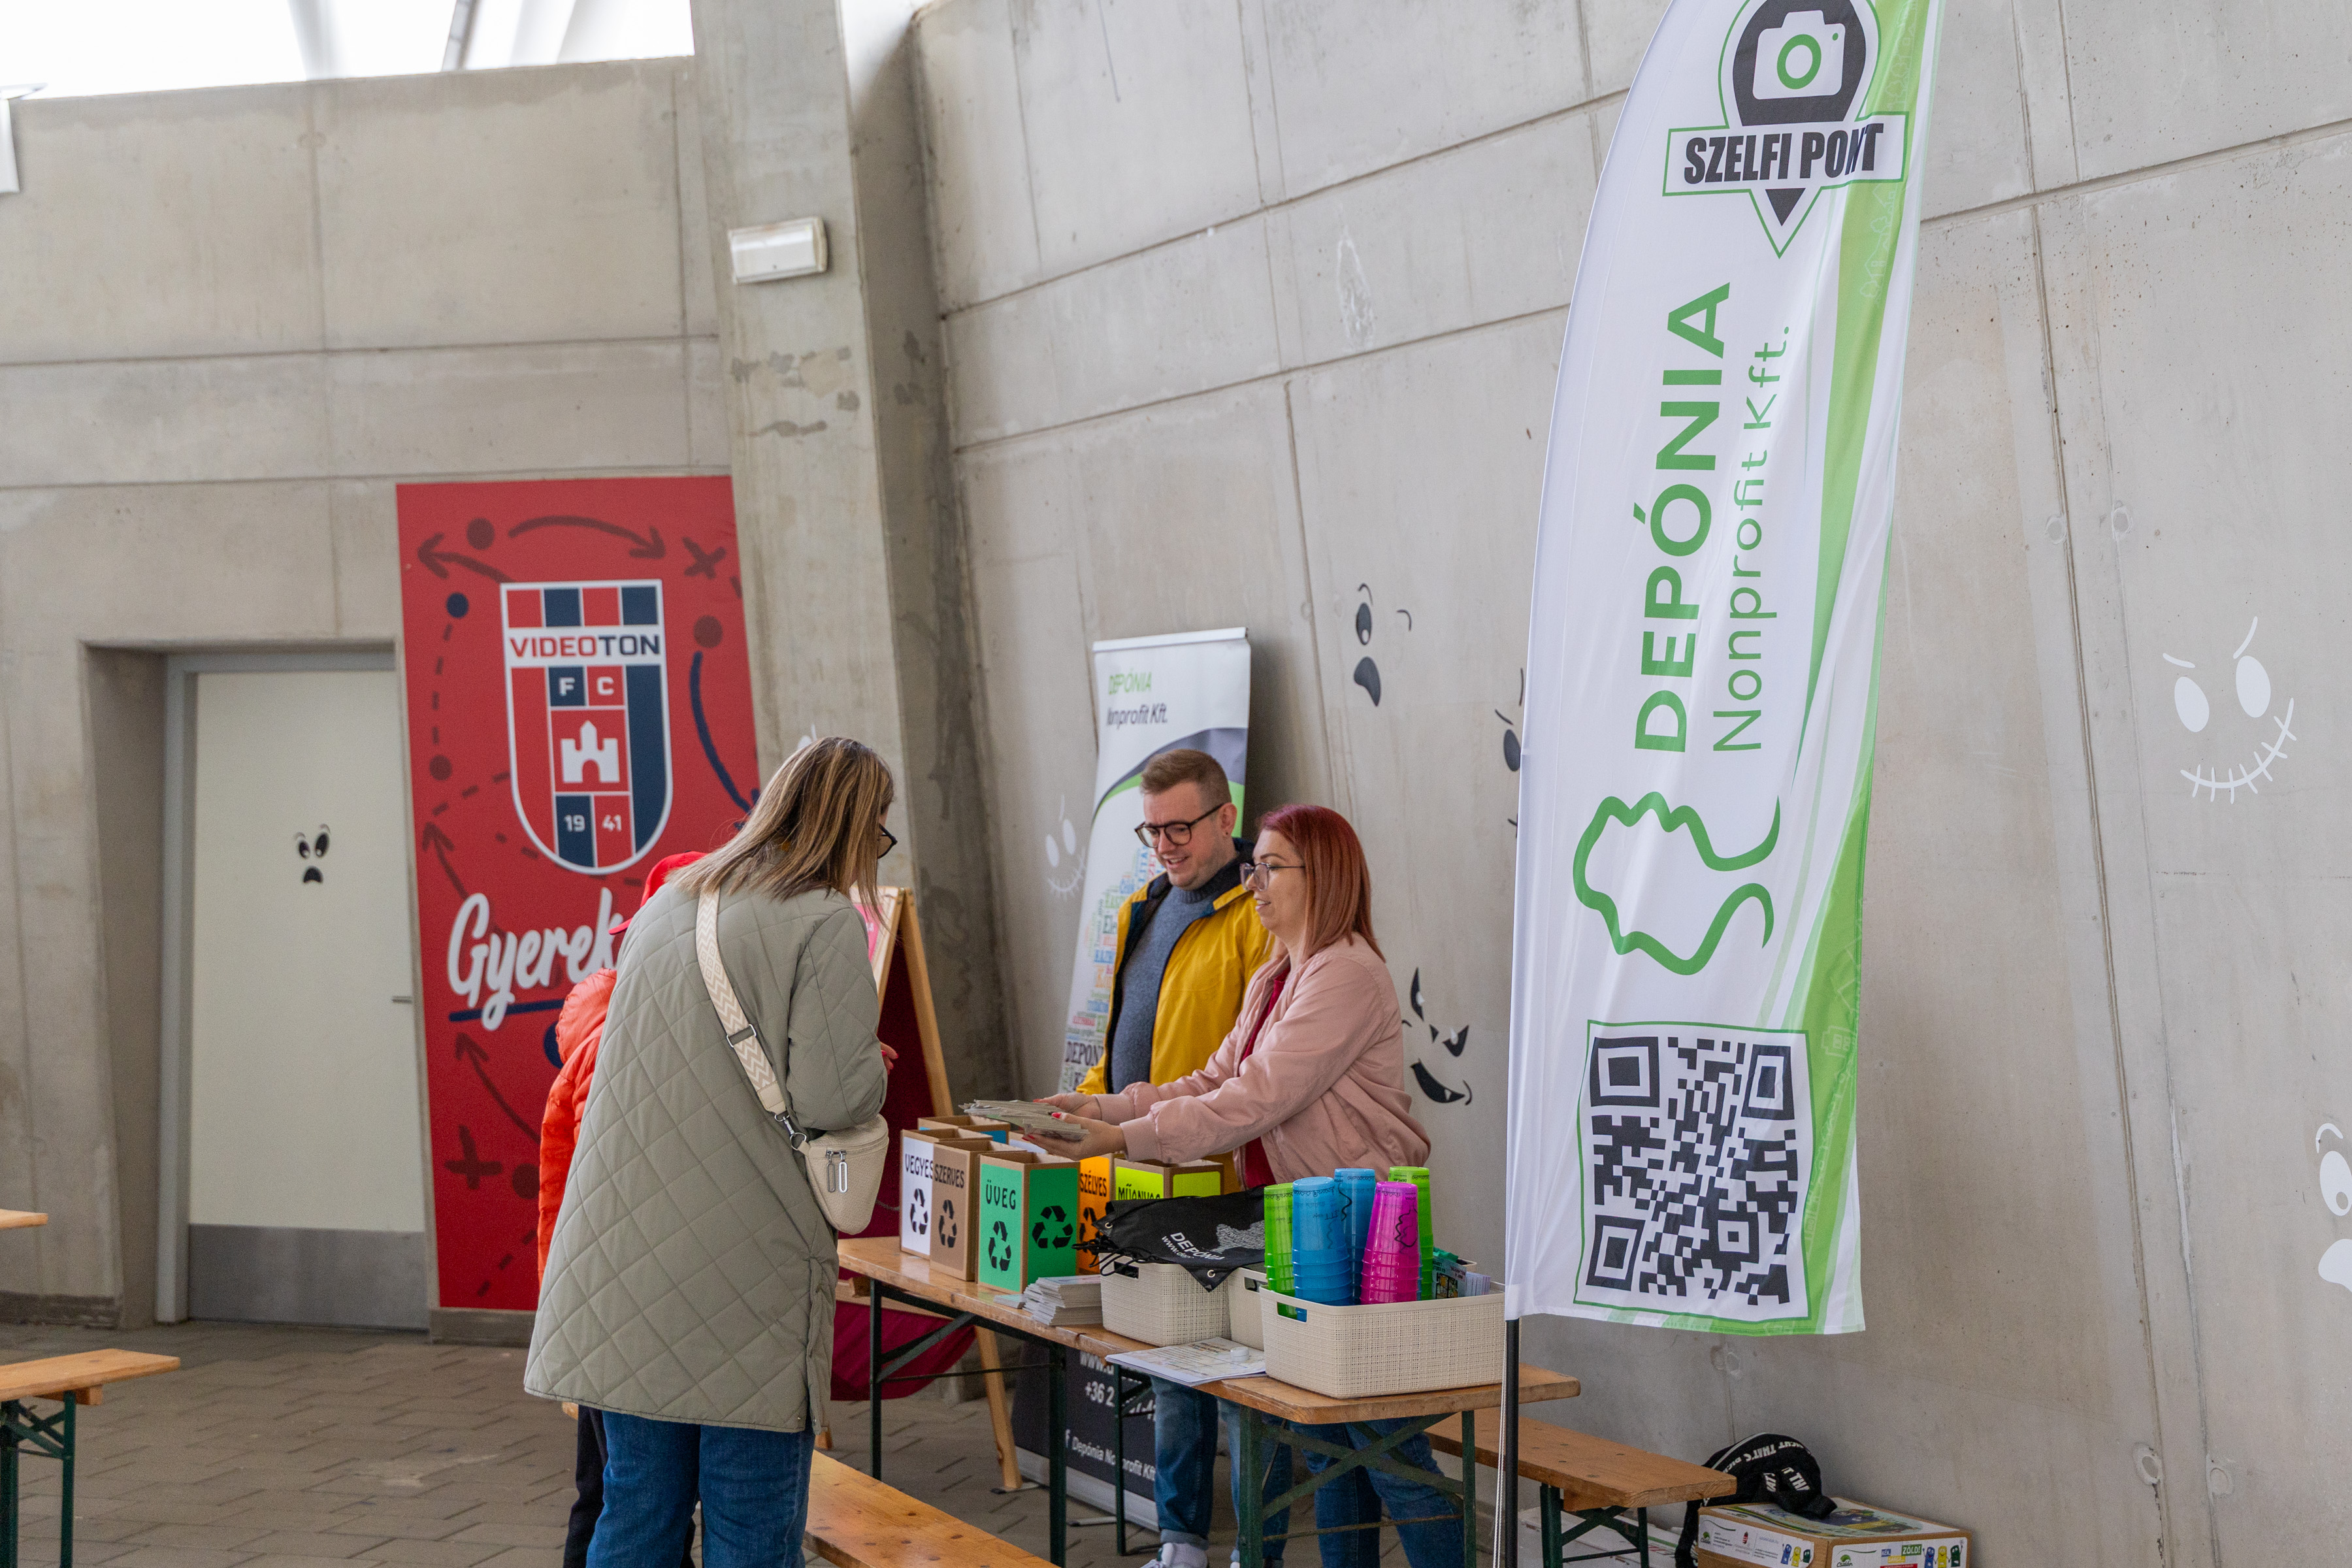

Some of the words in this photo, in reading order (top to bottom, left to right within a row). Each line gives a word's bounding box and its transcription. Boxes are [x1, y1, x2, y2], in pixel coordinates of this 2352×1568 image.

[1684, 133, 1792, 184] SZELFI
[1743, 326, 1789, 429] Kft.
[1633, 282, 1730, 753] DEPÓNIA
[1712, 449, 1777, 751] Nonprofit
[510, 633, 660, 658] VIDEOTON
[559, 677, 576, 696] F
[596, 676, 614, 696] C
[564, 814, 585, 833] 19
[602, 814, 622, 832] 41
[448, 887, 624, 1031] Gyerek
[905, 1153, 934, 1180] VEGYES
[934, 1163, 965, 1189] SZERVES
[986, 1179, 1017, 1211] ÜVEG
[1080, 1169, 1107, 1198] SZÉLYES
